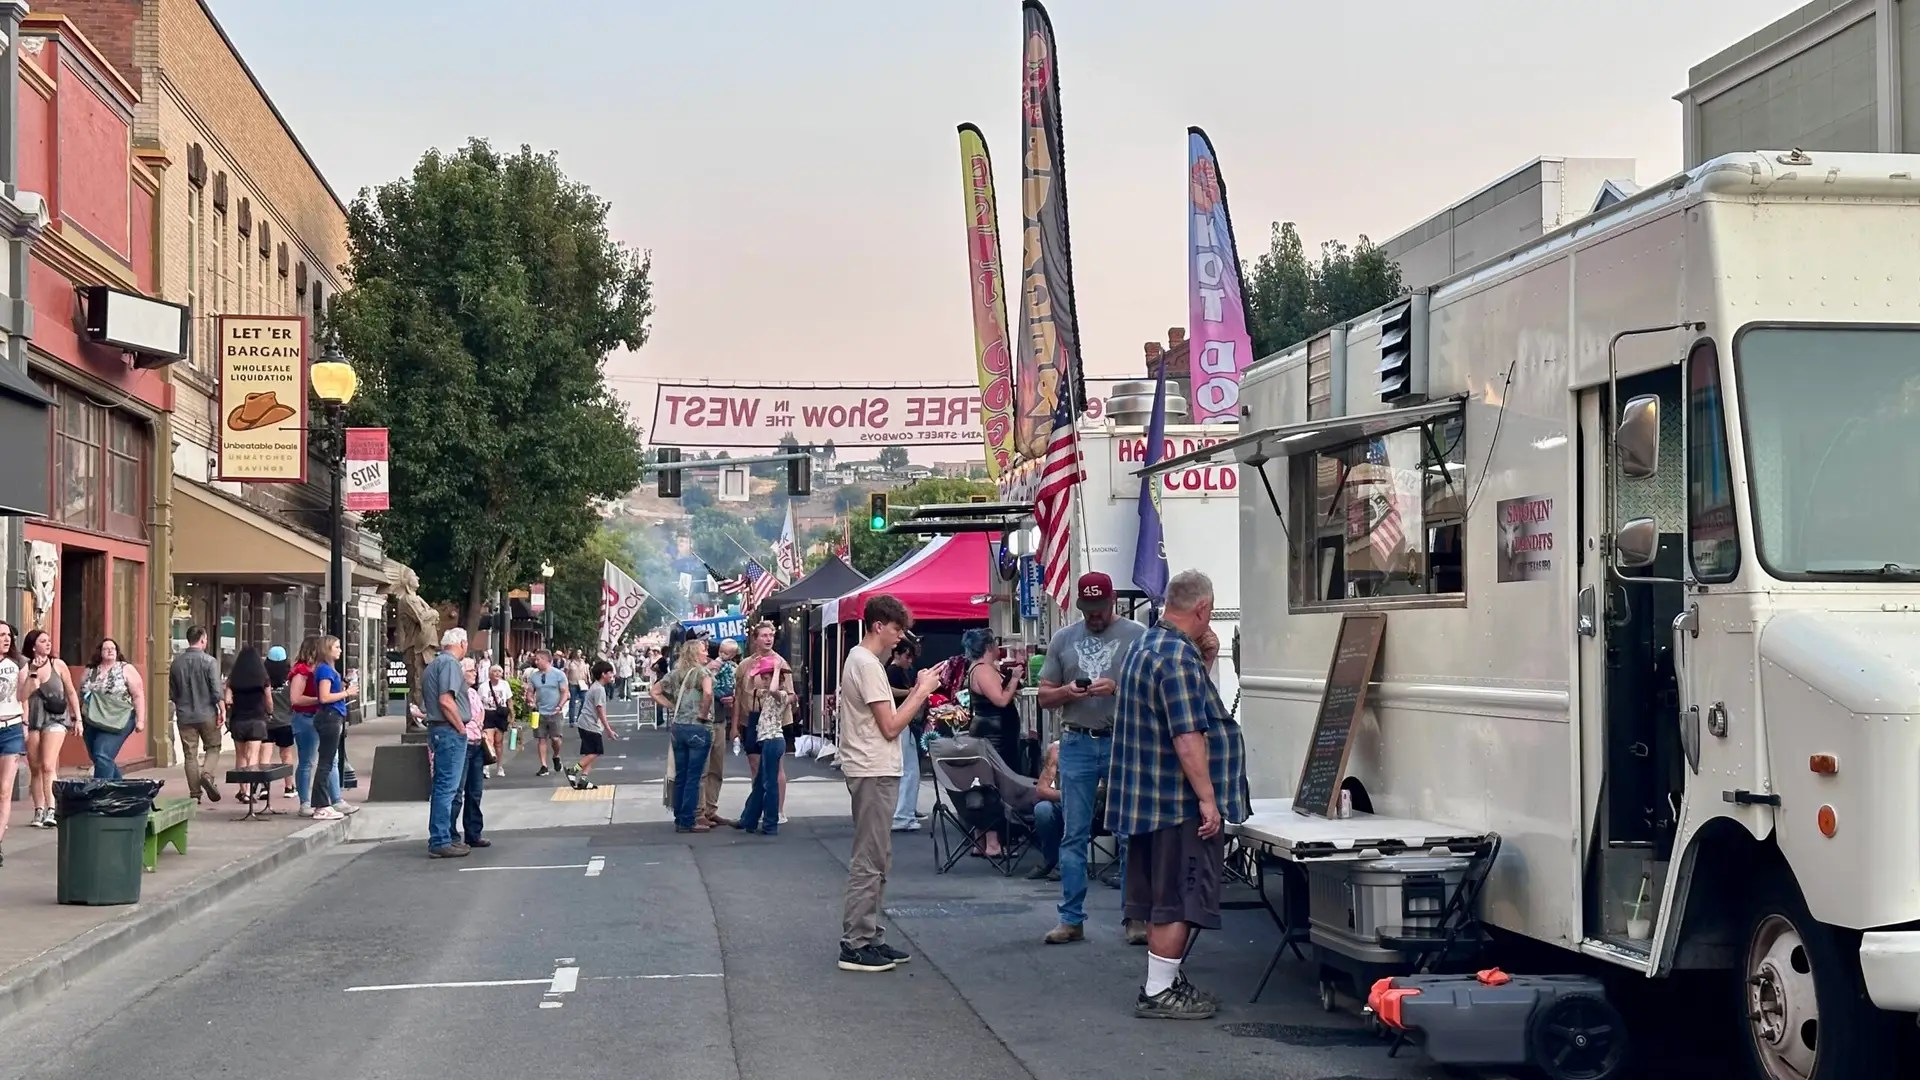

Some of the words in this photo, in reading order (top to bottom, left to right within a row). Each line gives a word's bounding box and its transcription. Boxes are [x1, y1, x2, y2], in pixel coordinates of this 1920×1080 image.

[233, 328, 262, 339] LET
[268, 327, 291, 339] 'ER
[228, 346, 299, 357] BARGAIN
[224, 442, 273, 450] Unbeatable
[1119, 439, 1176, 462] HAD
[351, 462, 381, 486] STAY
[1164, 468, 1237, 490] COLD
[1507, 498, 1552, 524] SMOKIN'
